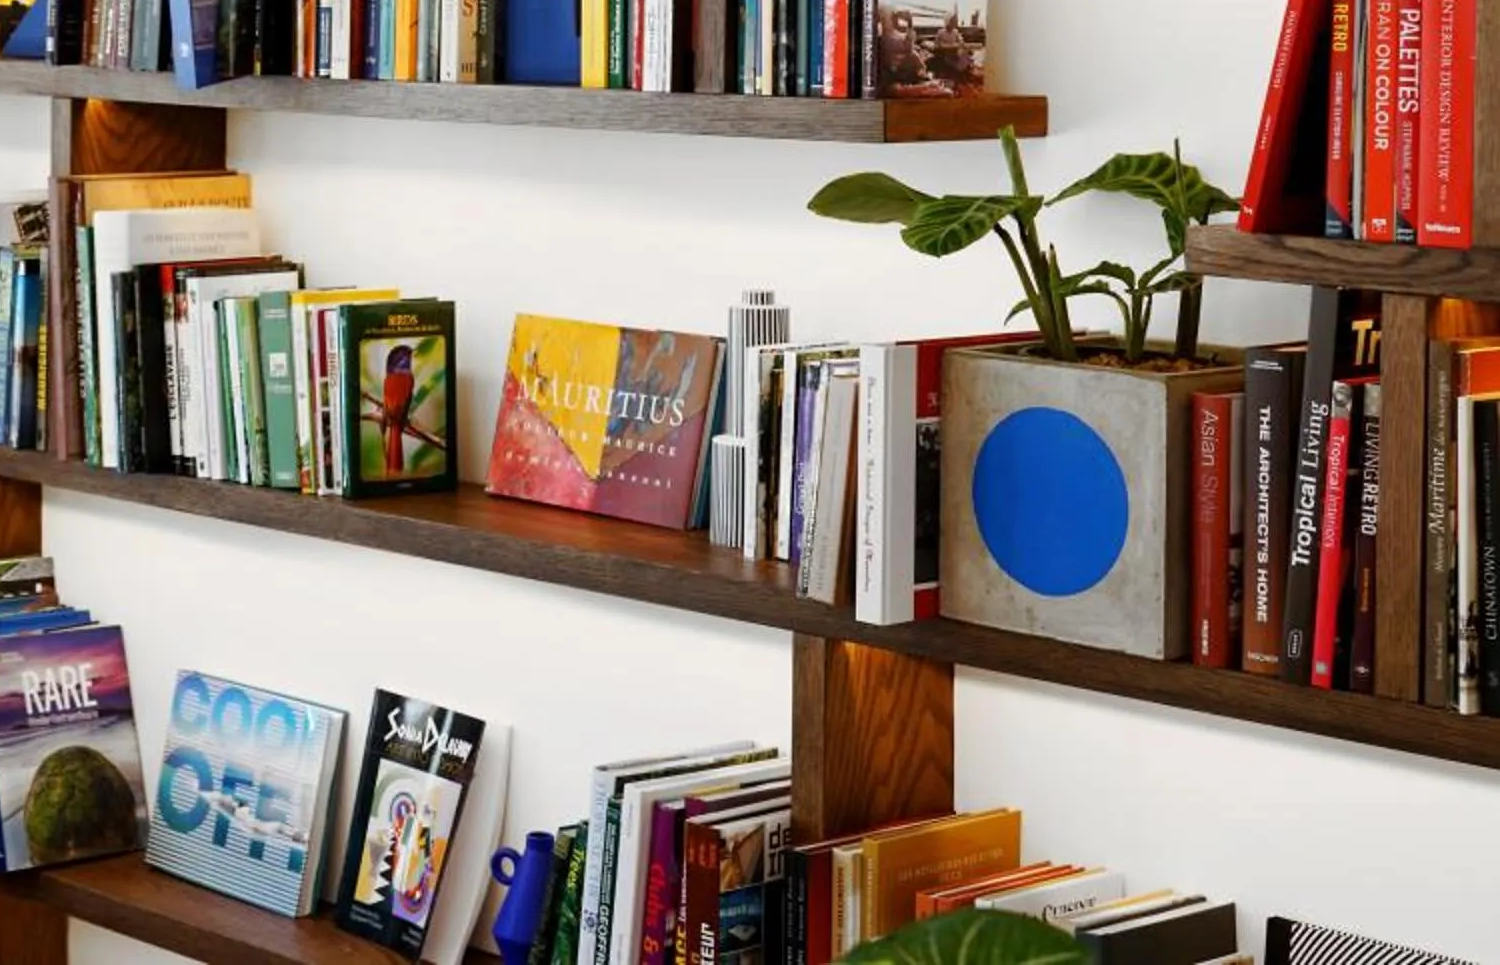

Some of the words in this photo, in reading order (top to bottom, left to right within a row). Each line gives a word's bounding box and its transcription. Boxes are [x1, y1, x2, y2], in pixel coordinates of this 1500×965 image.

[1332, 3, 1349, 53] RETRO
[1376, 43, 1391, 71] ON
[1398, 8, 1421, 113] PALETTES
[1375, 74, 1390, 150] COLOUR
[1439, 71, 1452, 124] DESIGN
[1438, 128, 1451, 182] REVIEW
[166, 345, 177, 420] L'ESCLAVAGE
[515, 376, 687, 427] MAURITIUS
[1201, 409, 1219, 467] Asian
[1259, 405, 1271, 441] THE
[1301, 401, 1329, 468] Living
[1328, 435, 1345, 491] Tropical
[1362, 422, 1380, 481] LIVING
[1198, 473, 1219, 524] Style
[1257, 446, 1271, 564] ARCHITECT'S
[1361, 483, 1379, 536] RETRO
[1428, 448, 1446, 535] Maritime
[1291, 475, 1317, 566] Tropical
[1323, 493, 1342, 548] Interiors
[1256, 568, 1269, 623] HOME
[1484, 546, 1498, 640] CHINATOWN
[20, 661, 98, 716] RARE
[566, 848, 587, 891] Trees
[644, 862, 665, 928] Clubs
[643, 936, 659, 954] &
